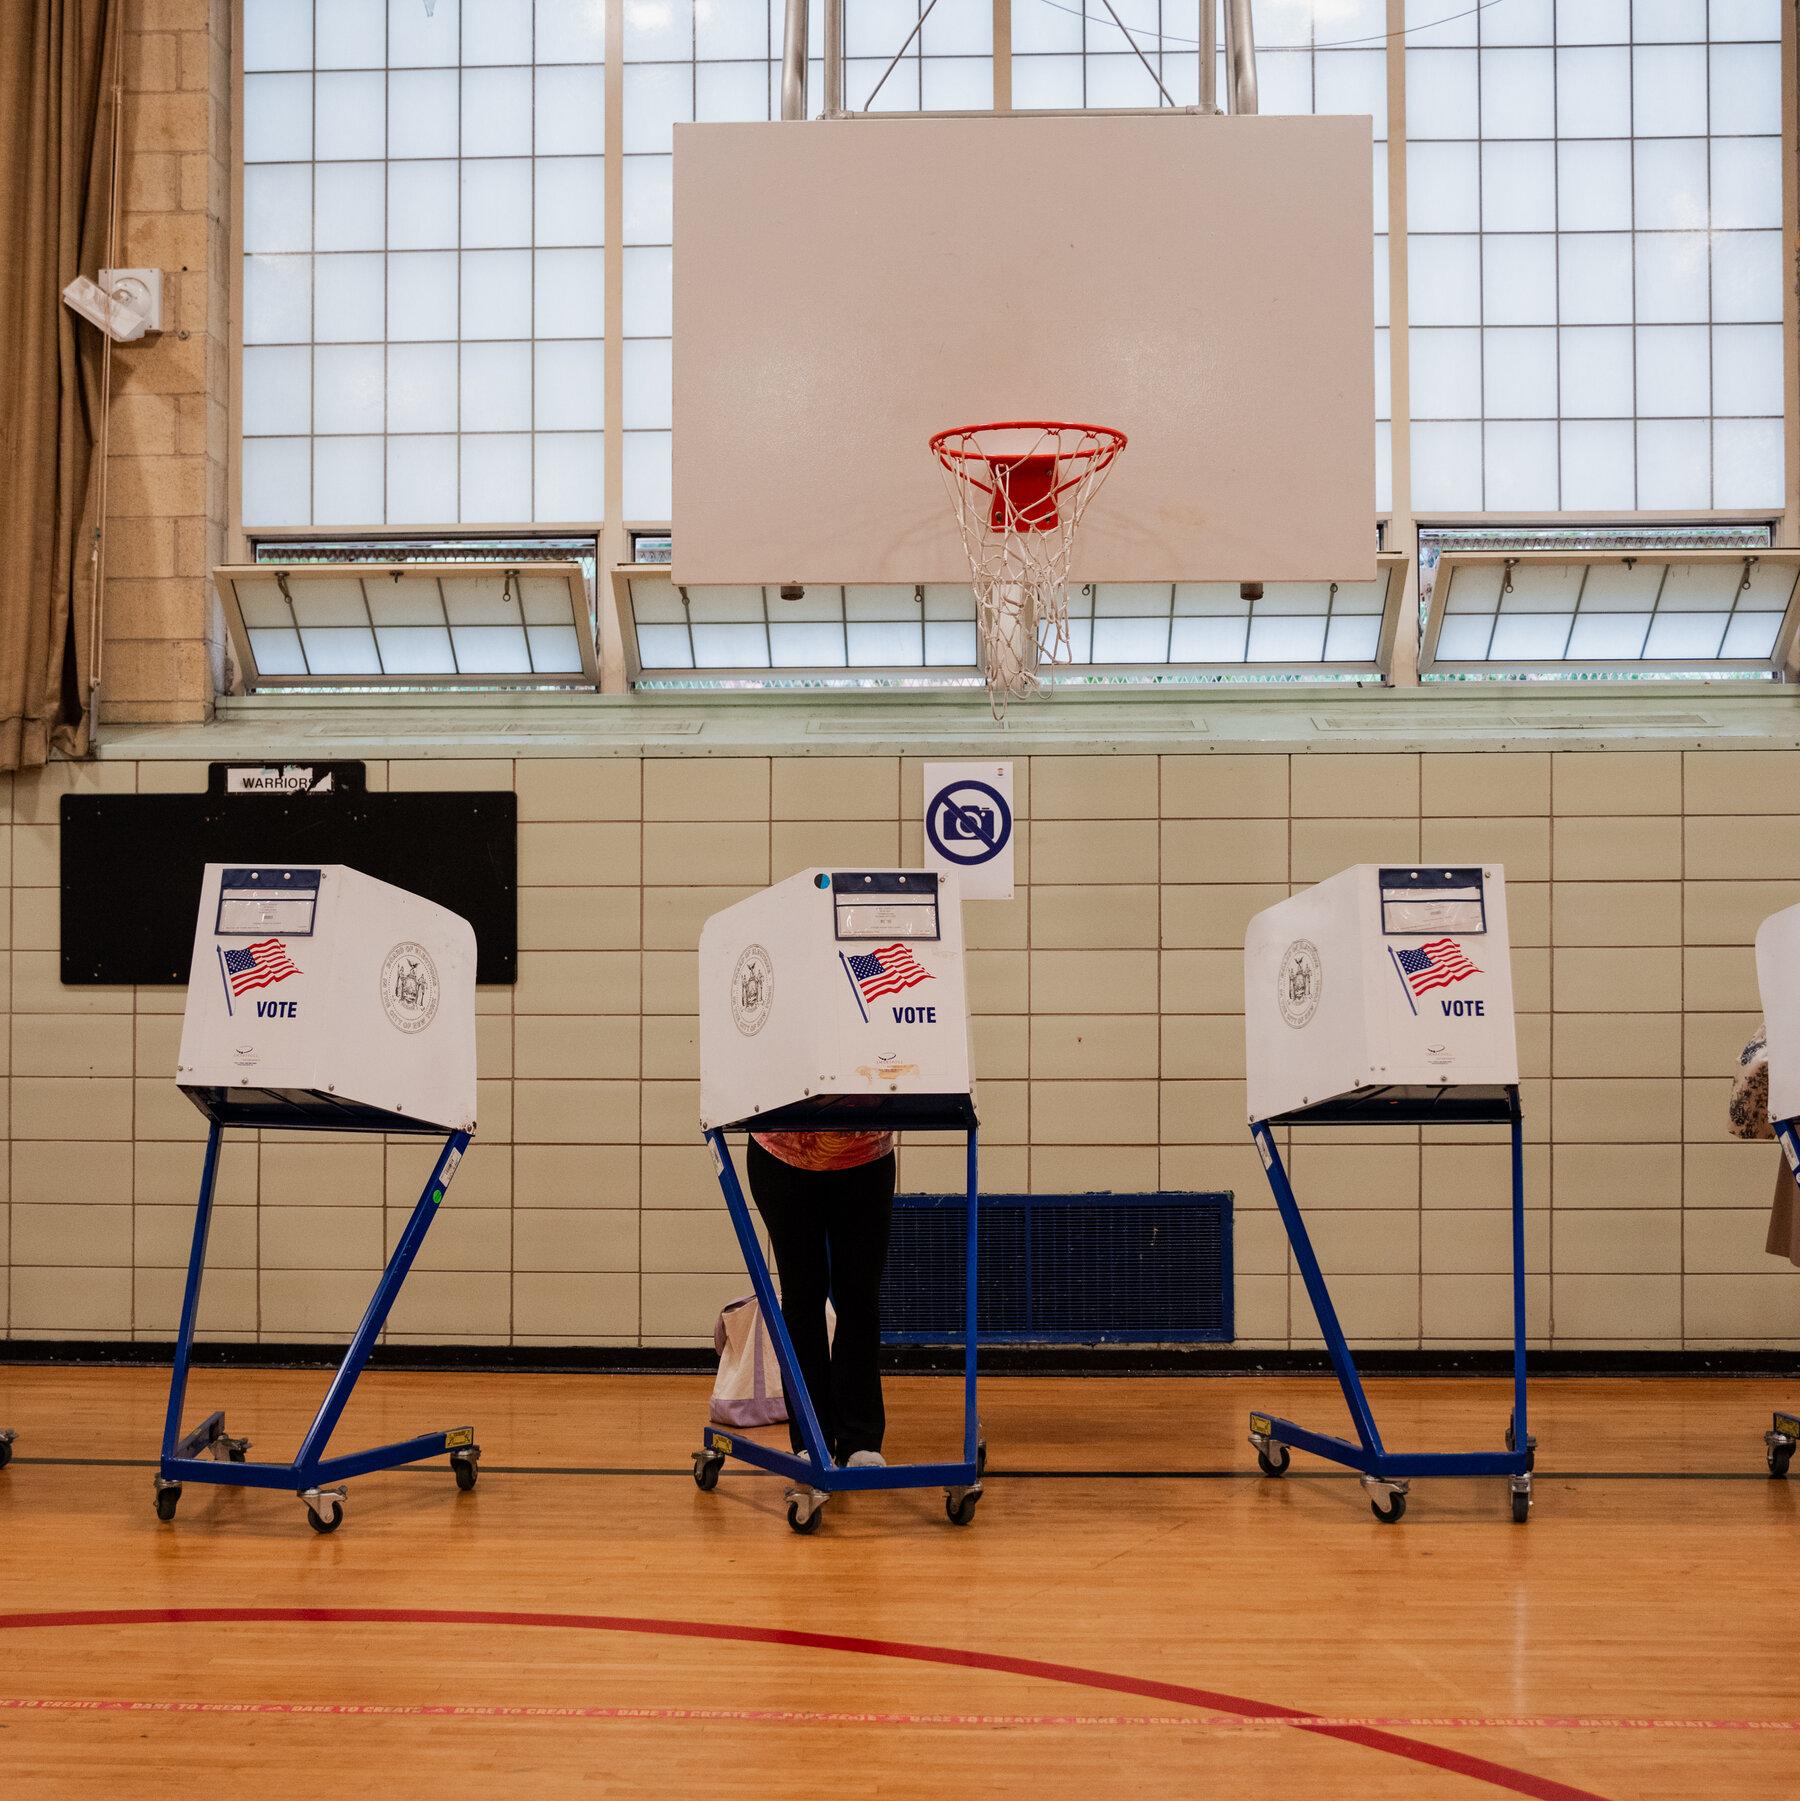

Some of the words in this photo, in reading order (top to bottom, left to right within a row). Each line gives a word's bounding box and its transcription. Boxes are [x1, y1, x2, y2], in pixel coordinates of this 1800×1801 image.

[256, 1001, 297, 1018] VOTE
[892, 1006, 936, 1024] VOTE
[1441, 1000, 1485, 1017] VOTE
